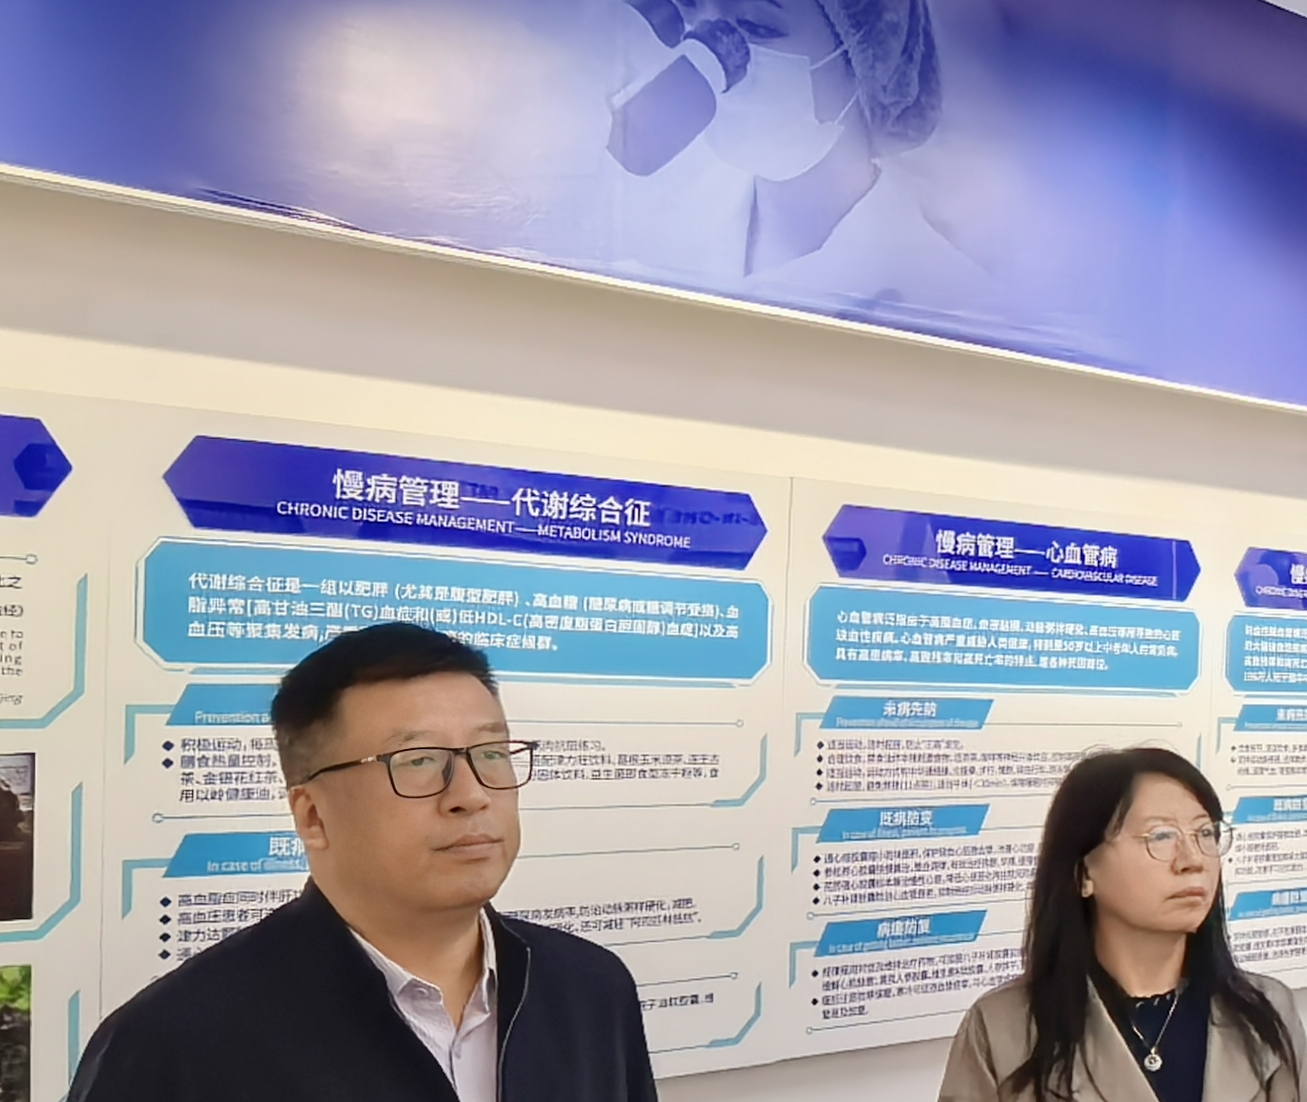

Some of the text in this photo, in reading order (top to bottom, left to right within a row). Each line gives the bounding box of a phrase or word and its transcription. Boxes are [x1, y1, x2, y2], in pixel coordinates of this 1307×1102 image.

[276, 500, 349, 520] CHRONIC
[352, 507, 413, 526] DISEASE
[624, 531, 691, 549] SYNDROME
[332, 467, 652, 528] 慢病管理——代谢综合征
